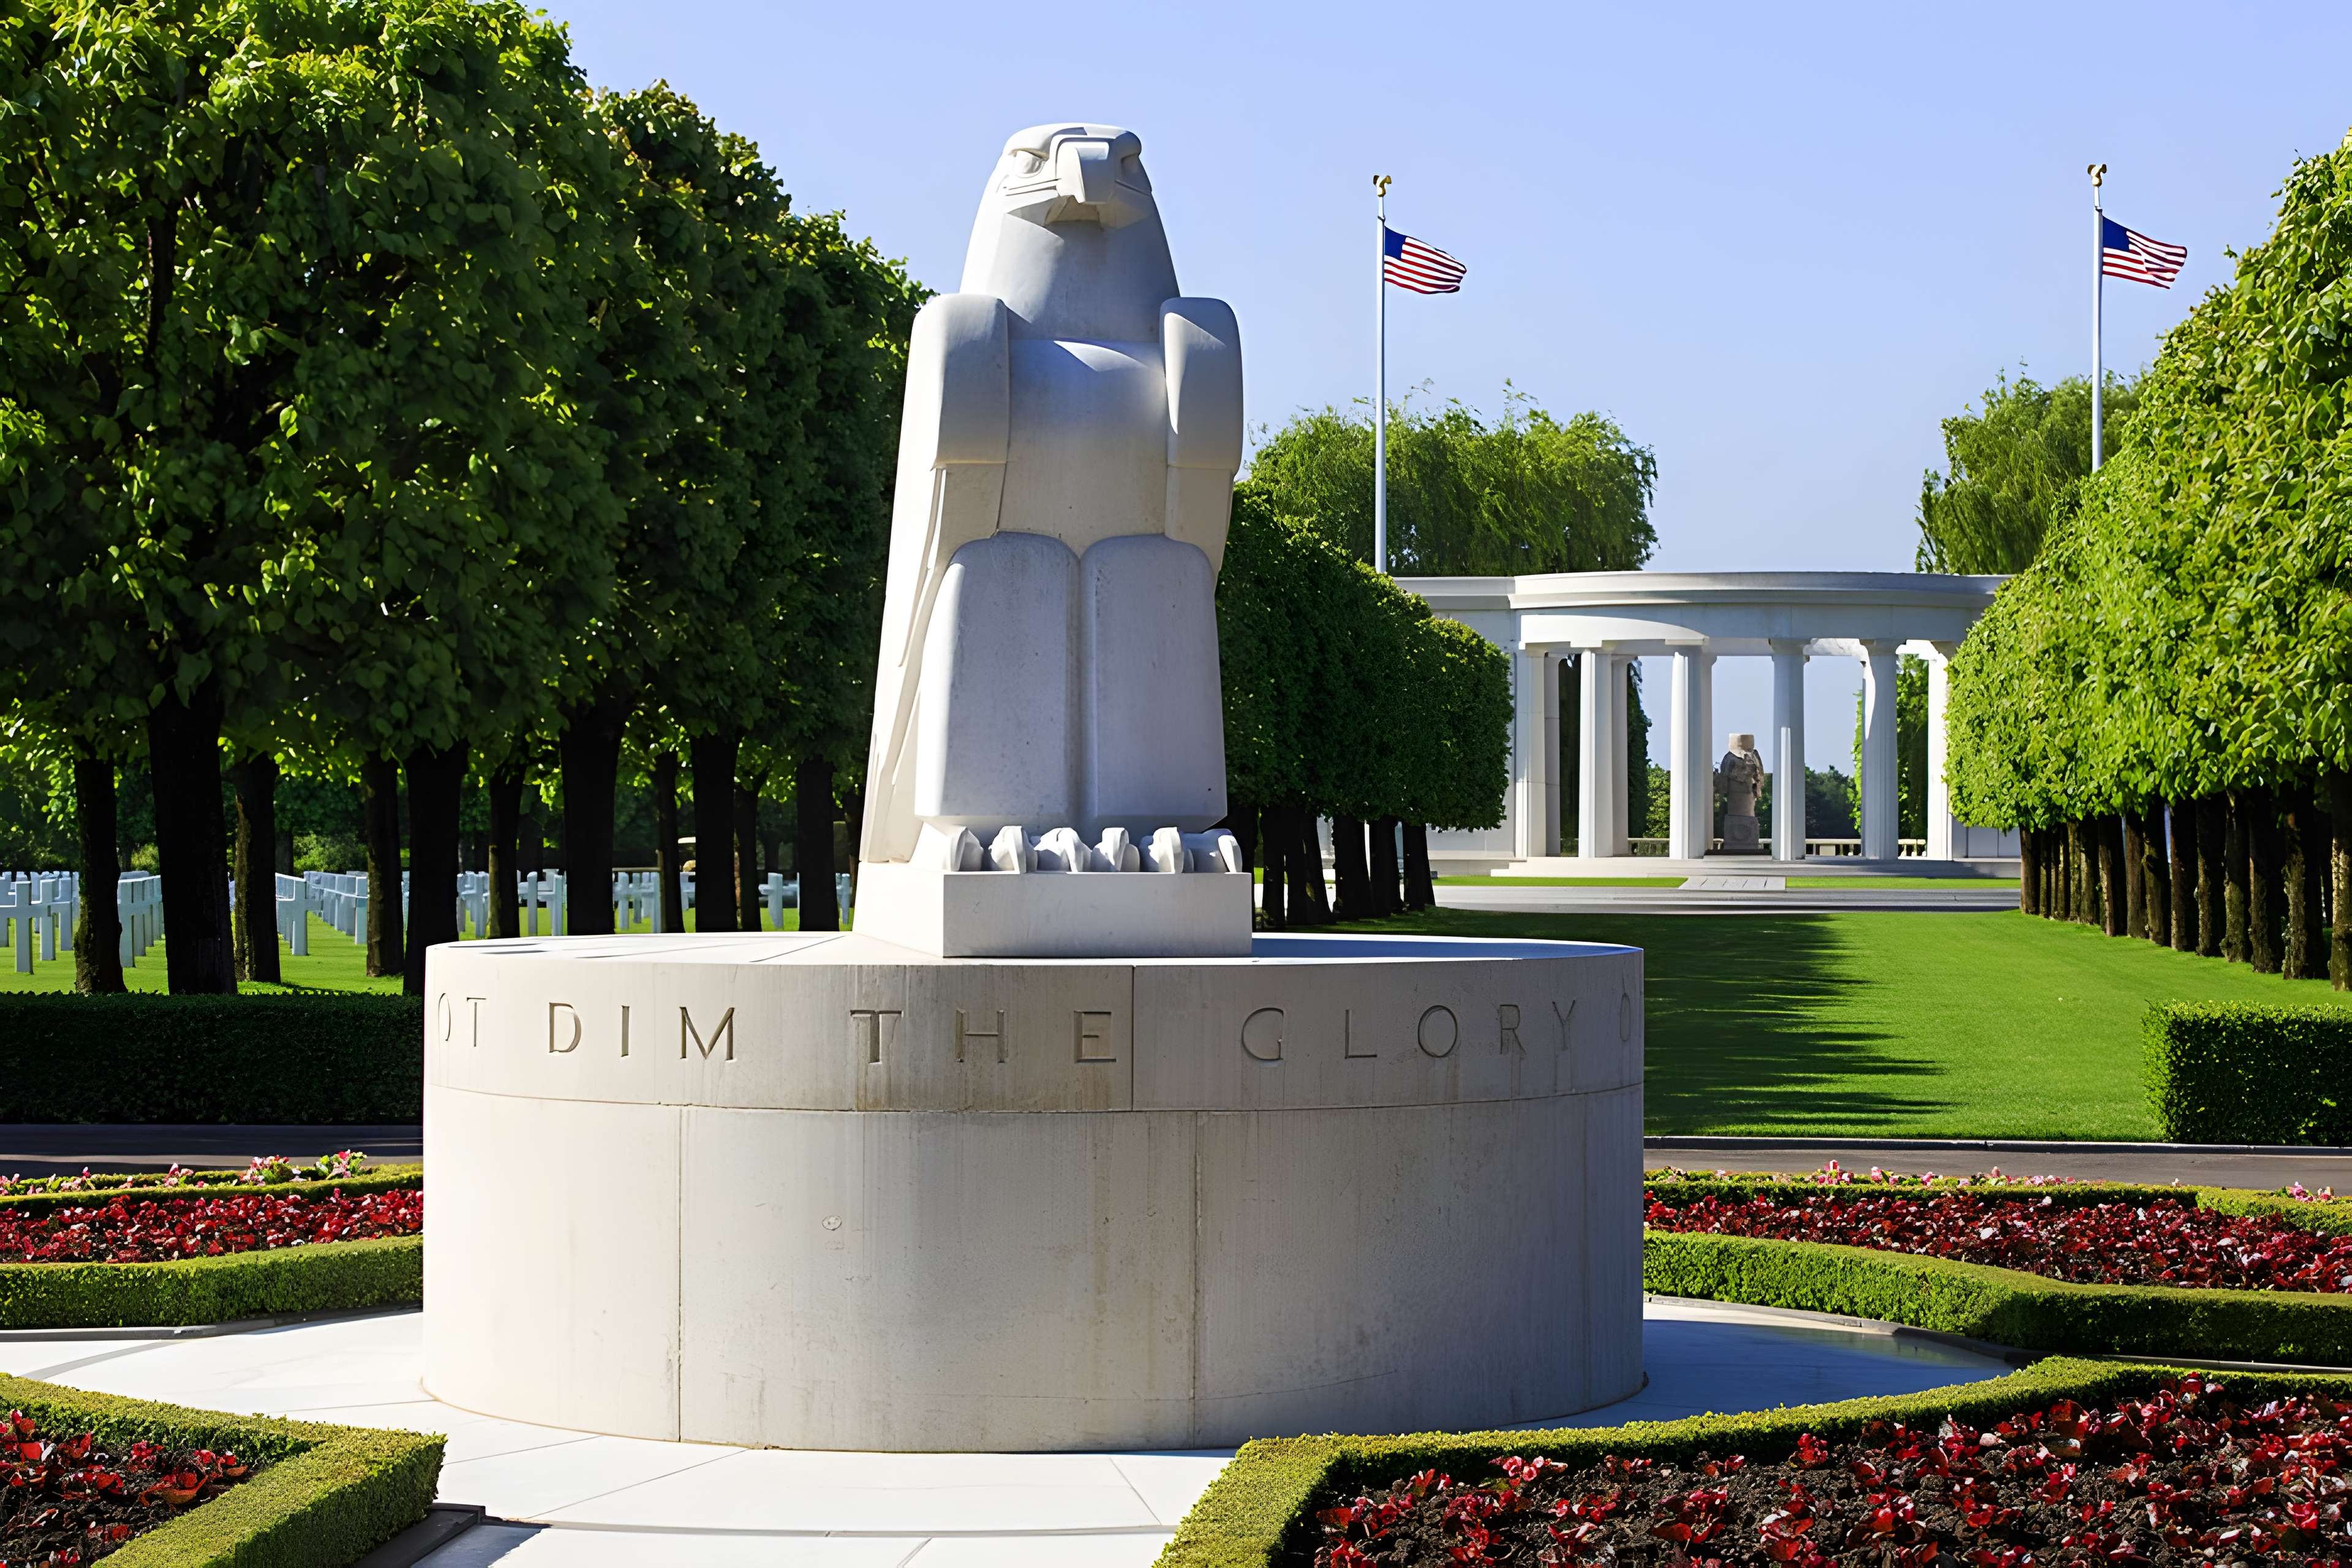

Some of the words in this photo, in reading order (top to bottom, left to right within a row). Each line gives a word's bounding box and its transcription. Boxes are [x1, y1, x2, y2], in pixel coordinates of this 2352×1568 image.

[548, 1002, 736, 1061] DIM
[850, 1008, 1117, 1064] THE
[1241, 1000, 1577, 1061] GLORY
